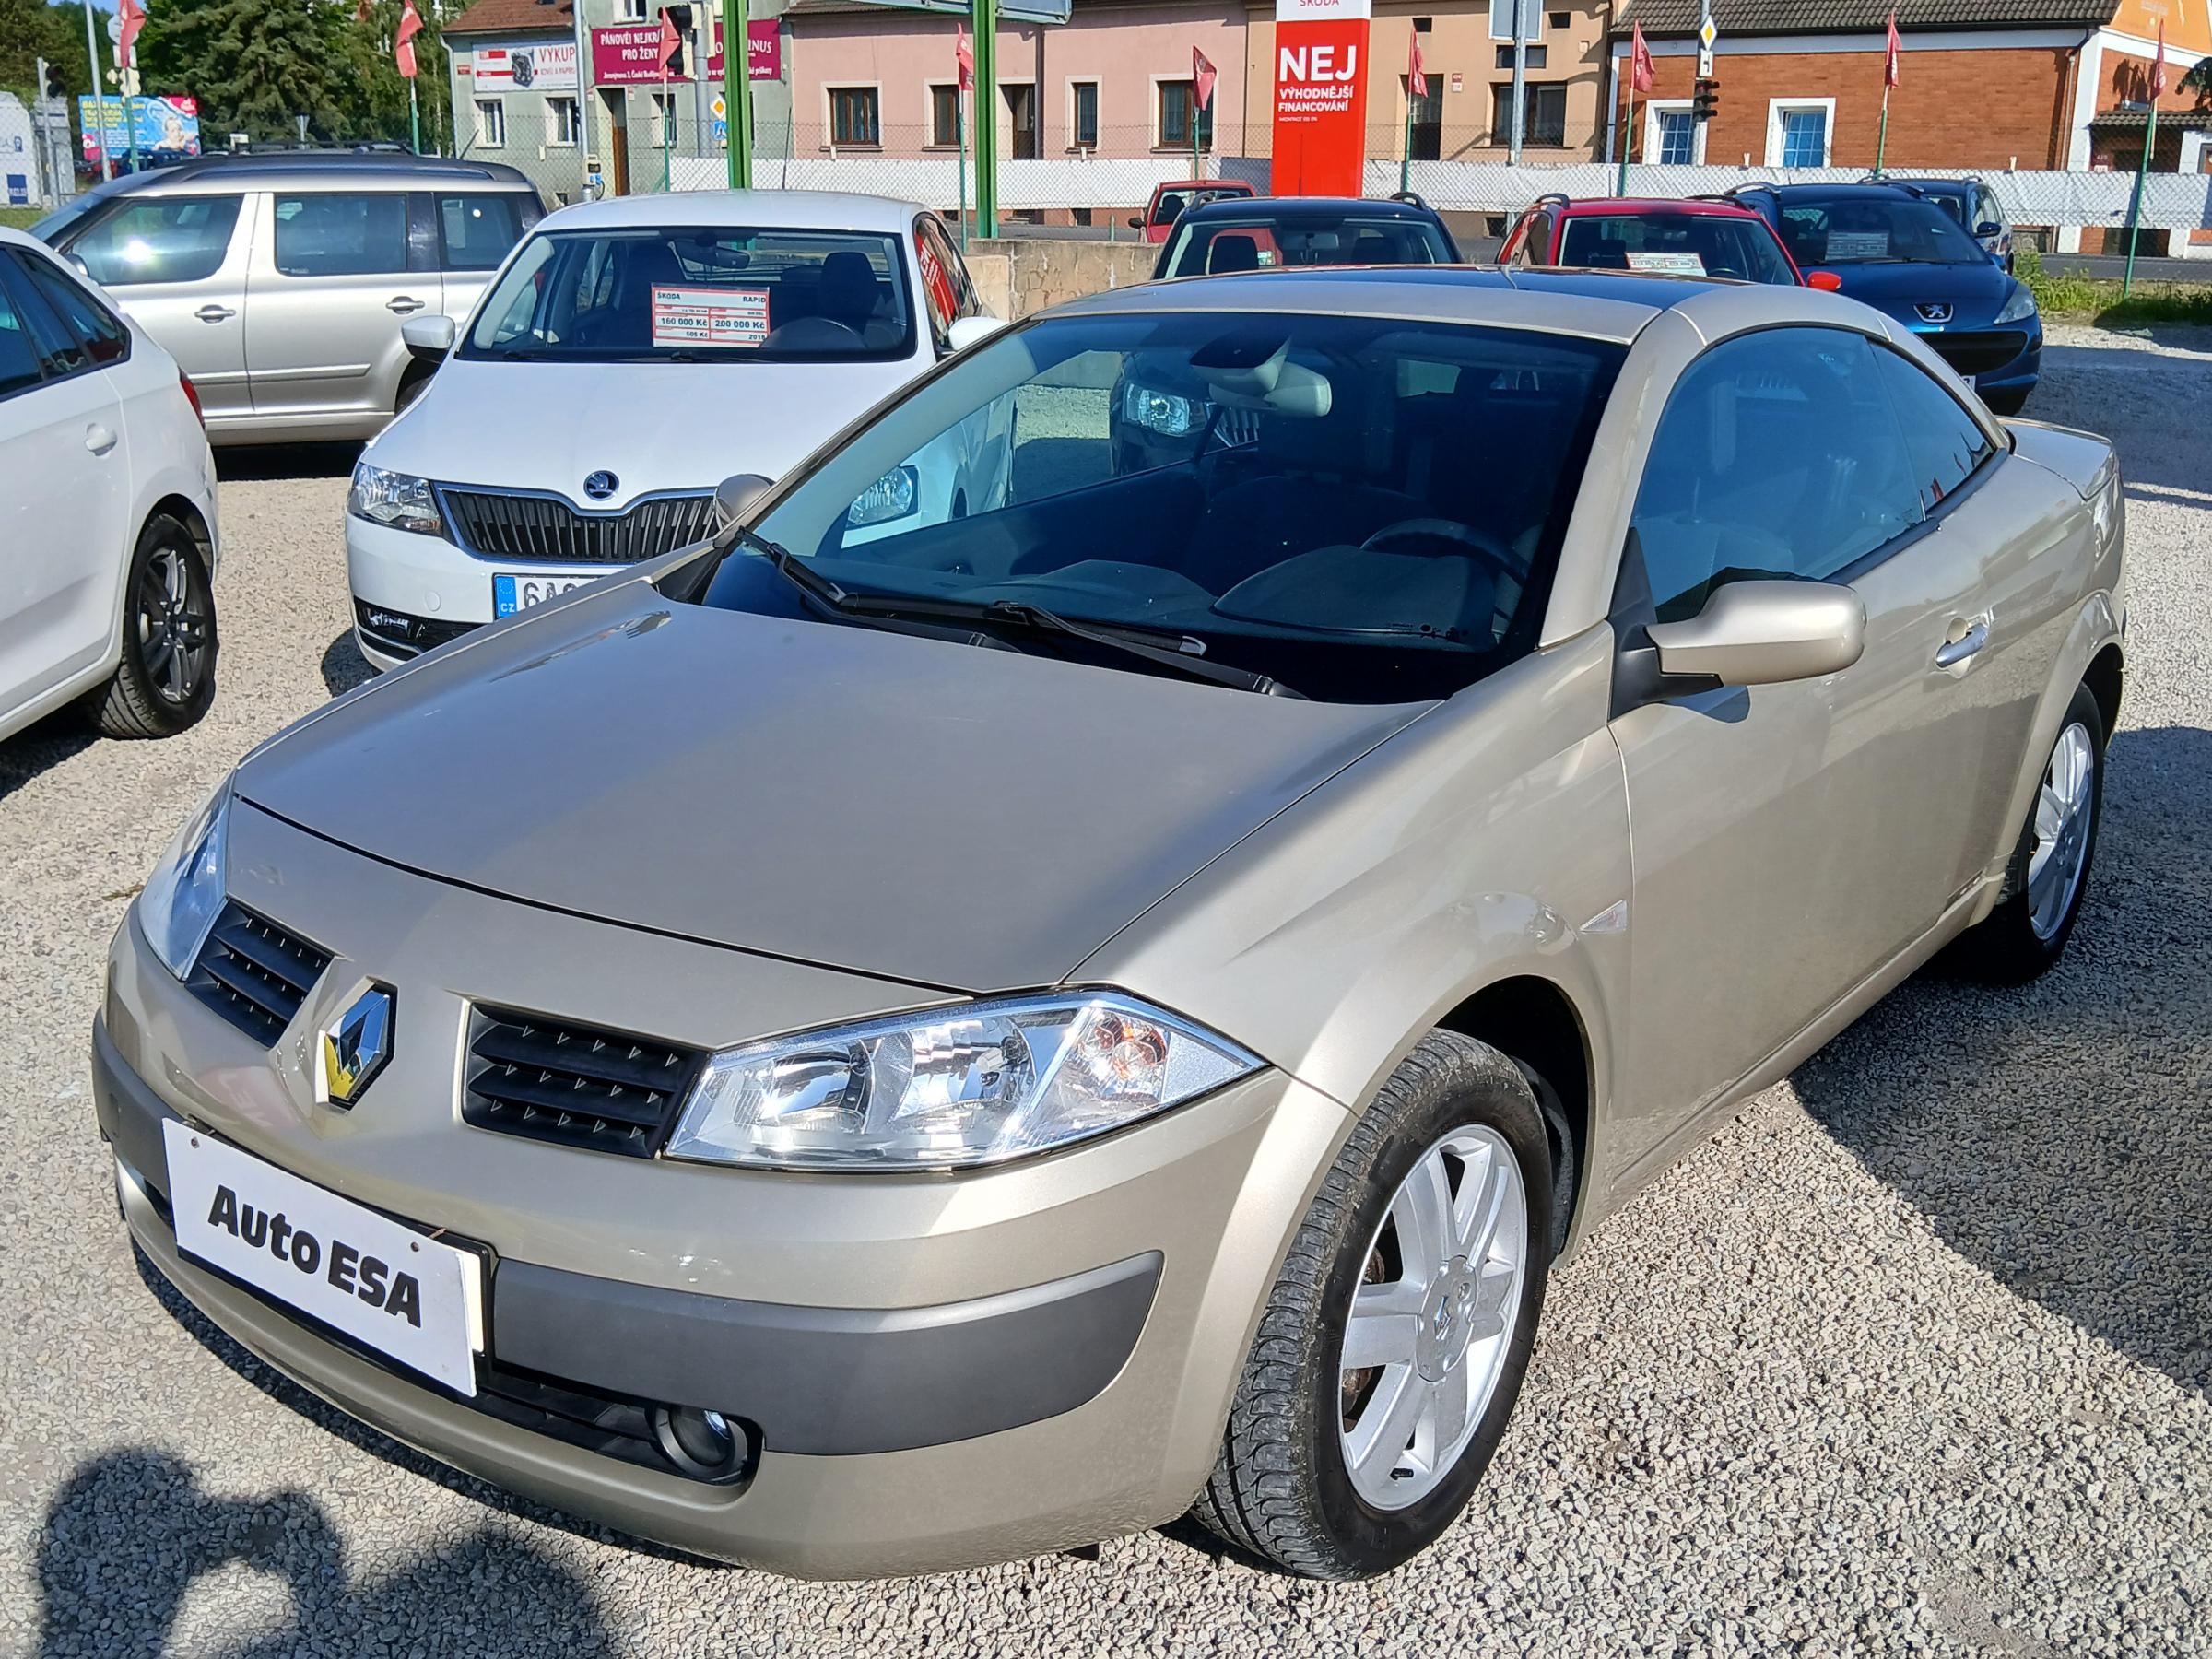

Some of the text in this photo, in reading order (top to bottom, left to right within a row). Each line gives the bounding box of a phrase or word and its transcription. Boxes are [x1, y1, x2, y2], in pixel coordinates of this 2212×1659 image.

[622, 46, 659, 60] PRO ŽENY
[1279, 45, 1357, 82] NEJ
[1279, 85, 1354, 100] VÝHODNĚJŠÍ
[1278, 100, 1348, 112] FINANCOVÁNÍ
[657, 291, 680, 300] ŠKODA
[500, 603, 515, 612] CZ
[208, 1185, 421, 1328] Auto ESA
